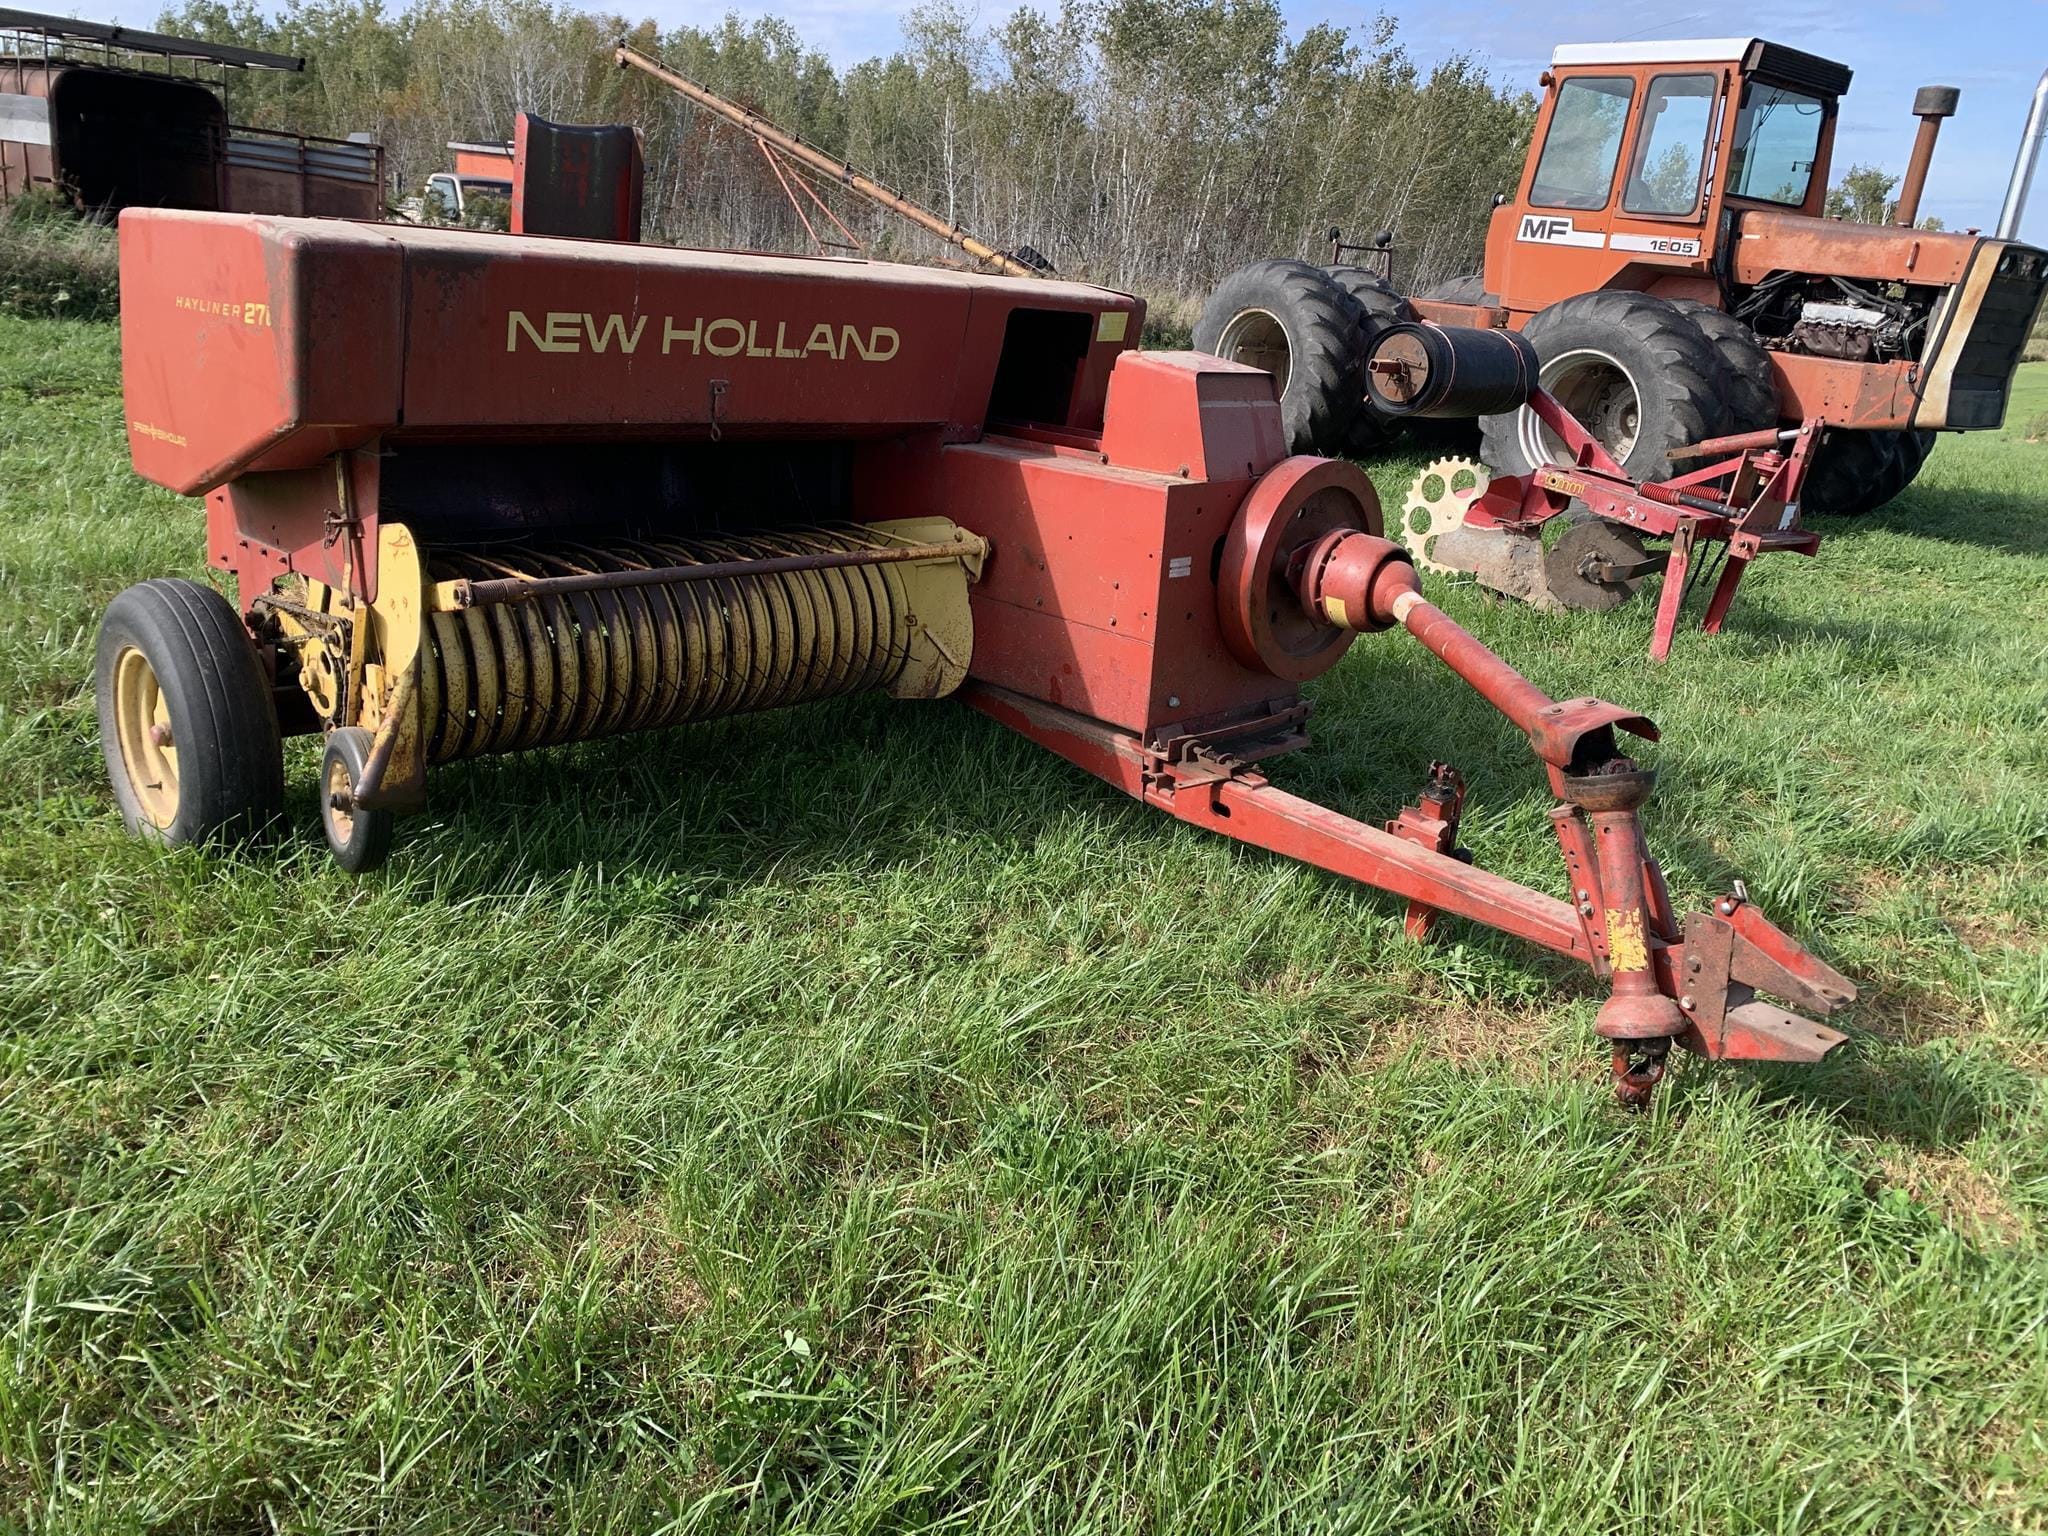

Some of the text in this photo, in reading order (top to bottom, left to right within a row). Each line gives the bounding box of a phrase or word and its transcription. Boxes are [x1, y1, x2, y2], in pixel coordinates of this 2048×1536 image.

[1522, 218, 1569, 240] MF
[1650, 240, 1693, 254] 1805
[175, 296, 241, 317] HAYLINER
[507, 311, 900, 362] NEW HOLLAND
